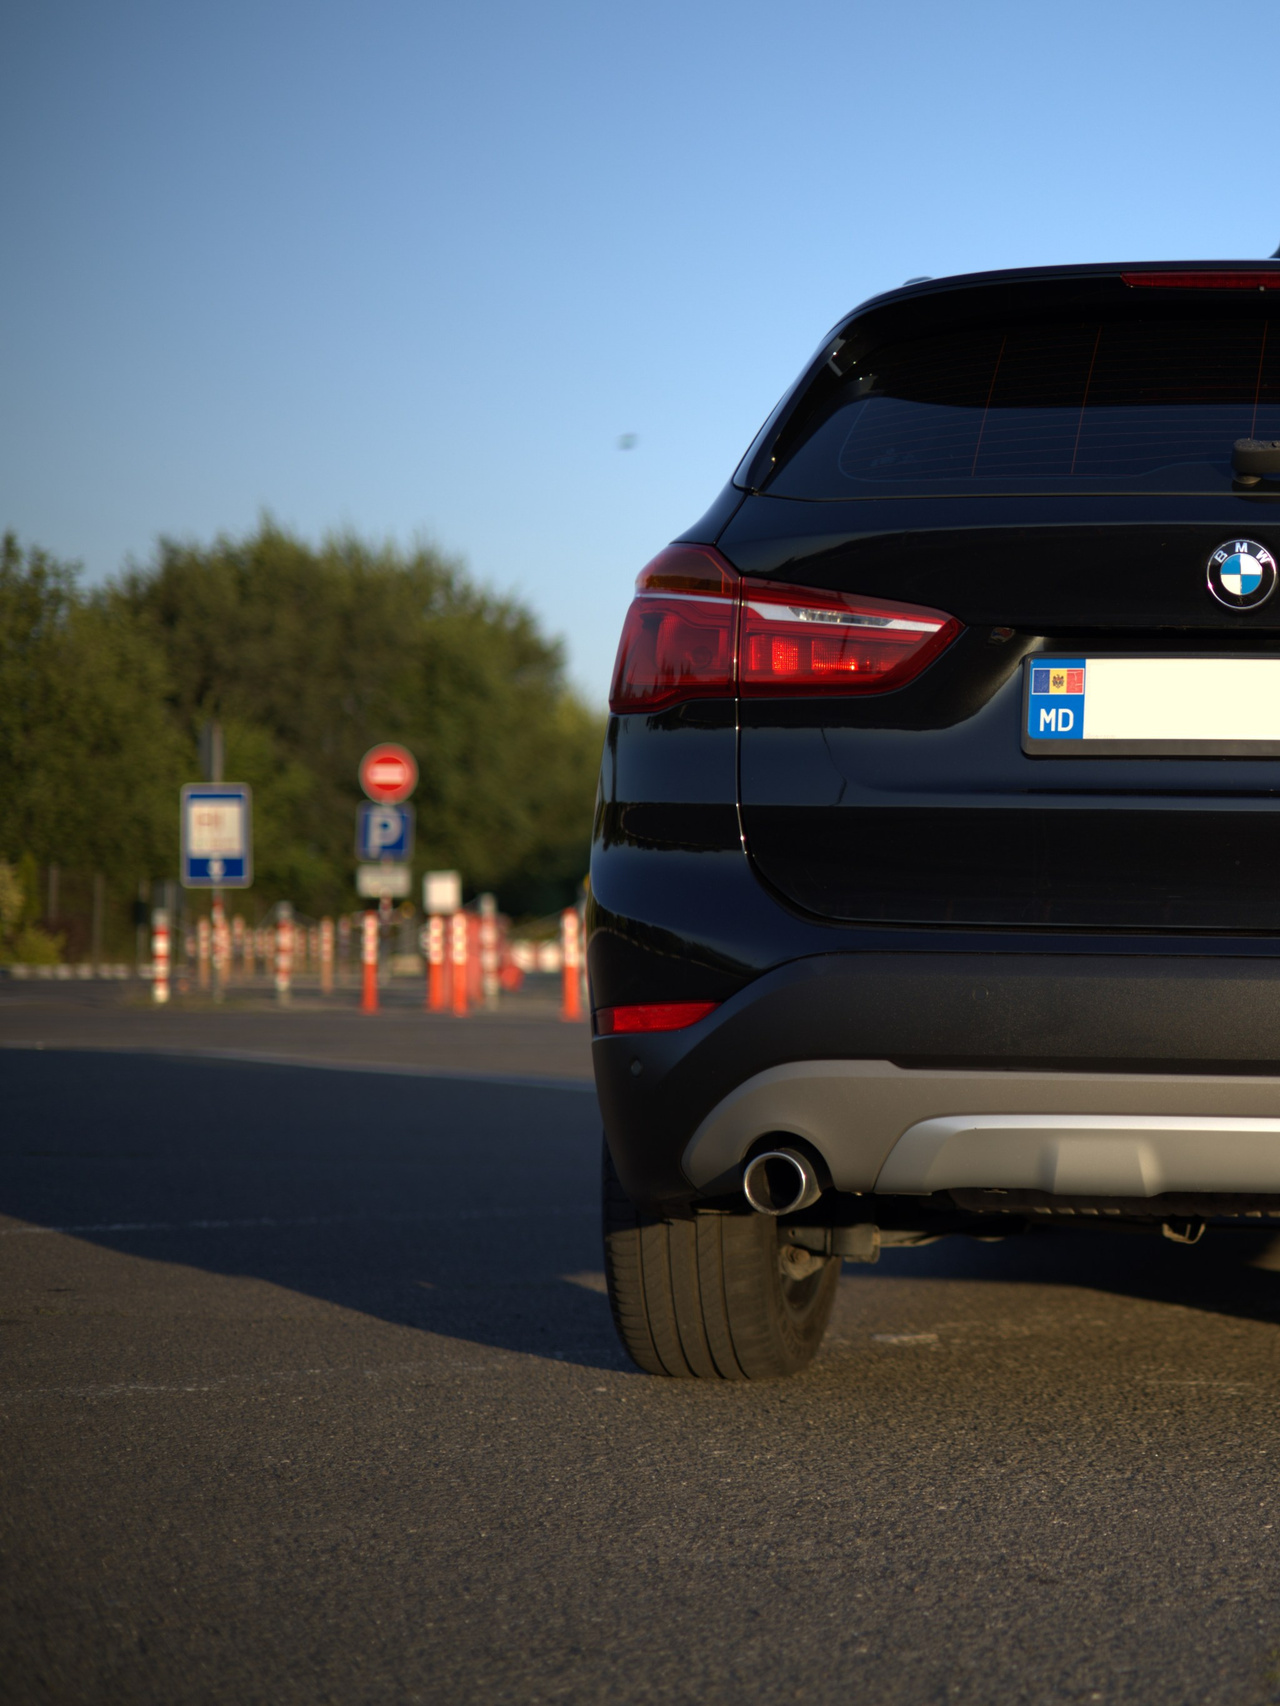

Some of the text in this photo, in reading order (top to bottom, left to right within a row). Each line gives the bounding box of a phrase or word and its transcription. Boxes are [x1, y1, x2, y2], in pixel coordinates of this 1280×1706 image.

[1214, 542, 1271, 564] BMW
[1039, 708, 1074, 732] MD
[367, 805, 402, 858] P
